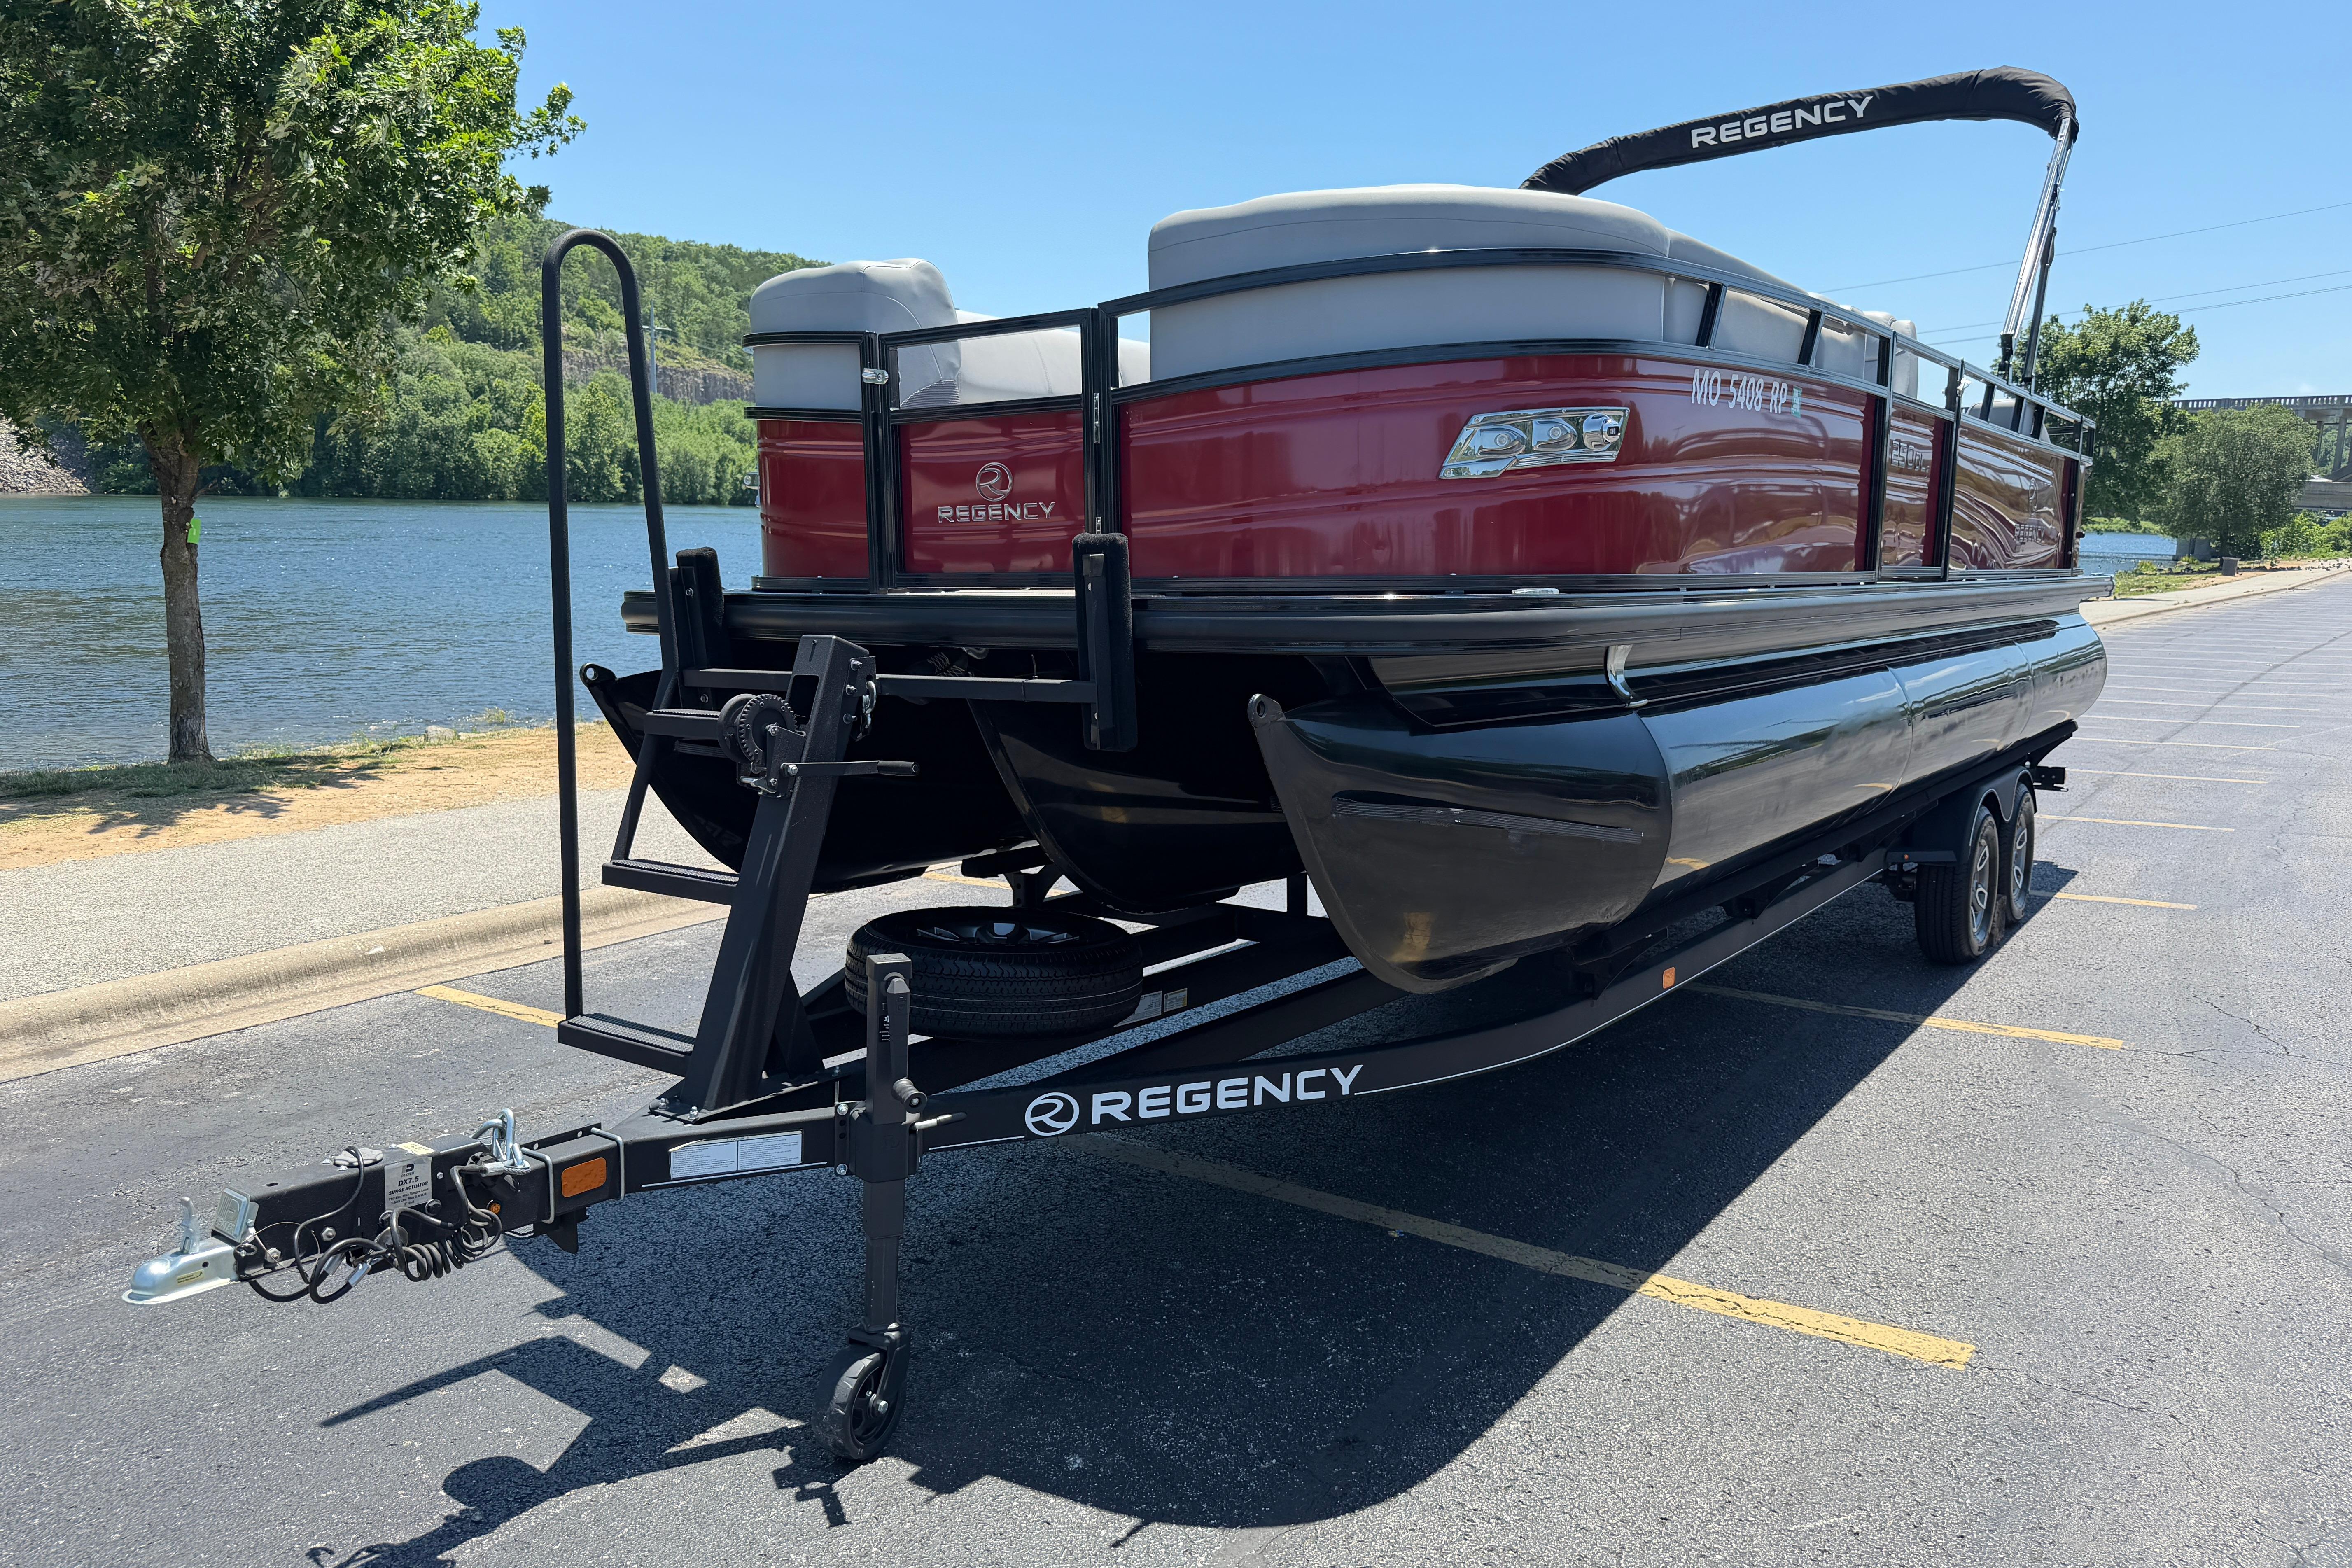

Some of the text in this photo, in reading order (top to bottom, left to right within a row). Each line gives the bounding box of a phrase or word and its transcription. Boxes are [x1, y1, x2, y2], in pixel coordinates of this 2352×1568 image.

[1691, 96, 1873, 149] REGENCY
[1691, 368, 1721, 406] MO
[1727, 374, 1764, 412] 5408
[1769, 381, 1788, 414] RP
[938, 502, 1056, 523] REGENCY
[1091, 1064, 1363, 1125] REGENCY
[398, 1176, 419, 1186] DX7.5
[405, 1181, 428, 1191] ACTUATOR
